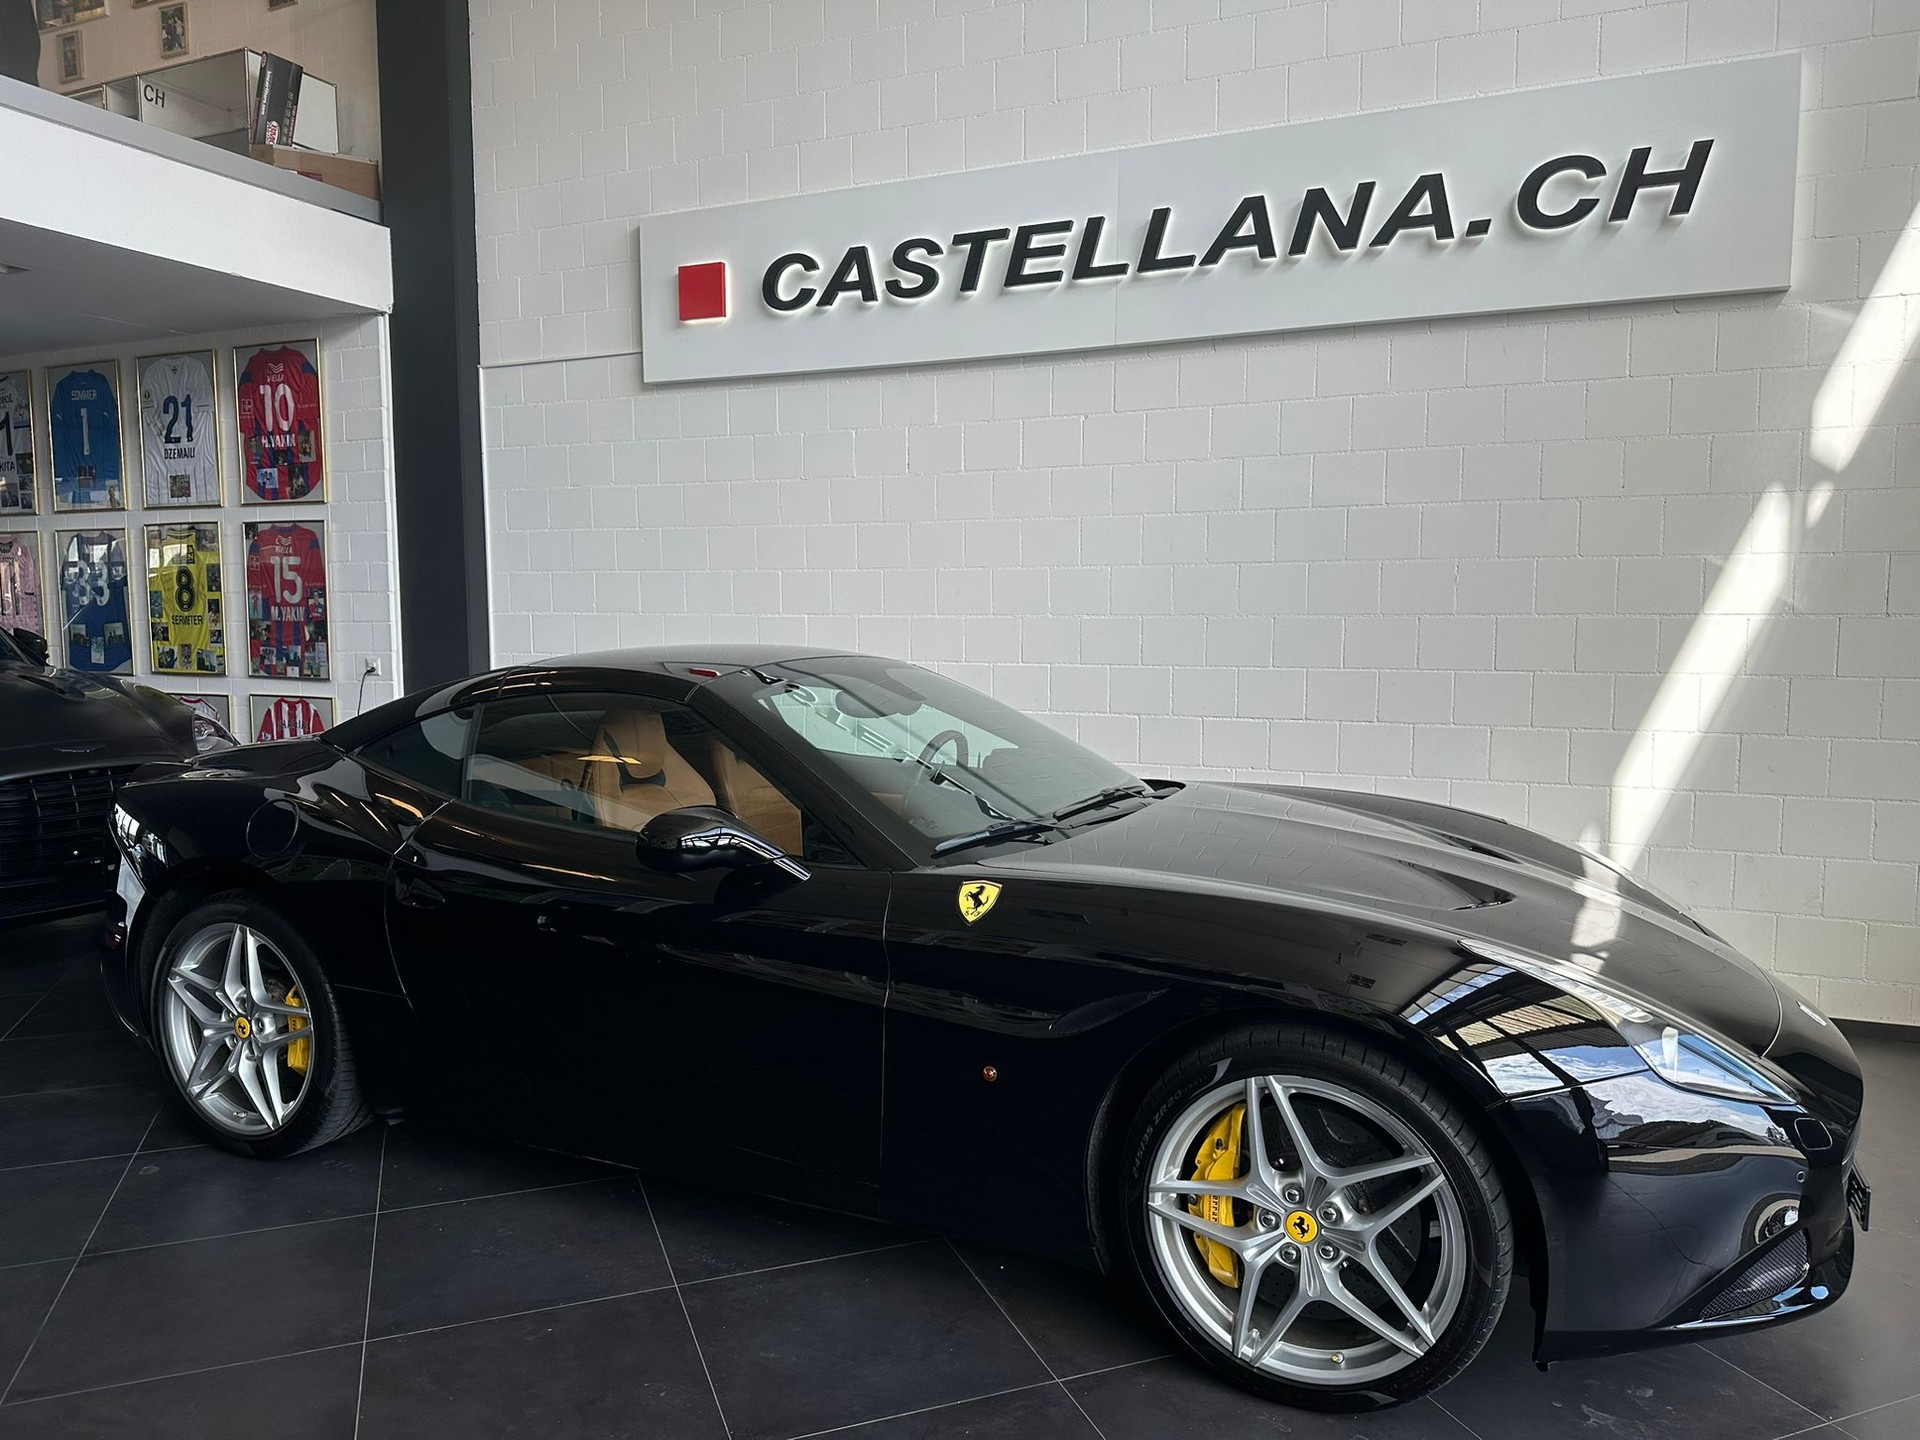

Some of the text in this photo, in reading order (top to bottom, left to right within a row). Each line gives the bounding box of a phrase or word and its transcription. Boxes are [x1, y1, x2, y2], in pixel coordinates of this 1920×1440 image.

[143, 84, 165, 108] CH
[761, 138, 1714, 313] CASTELLANA.CH
[71, 389, 97, 401] SOMMER
[162, 394, 194, 444] 21
[259, 383, 295, 432] 10
[80, 407, 90, 456] 1
[175, 565, 196, 612] 8
[269, 555, 303, 604] 15
[171, 614, 203, 627] SERMETER
